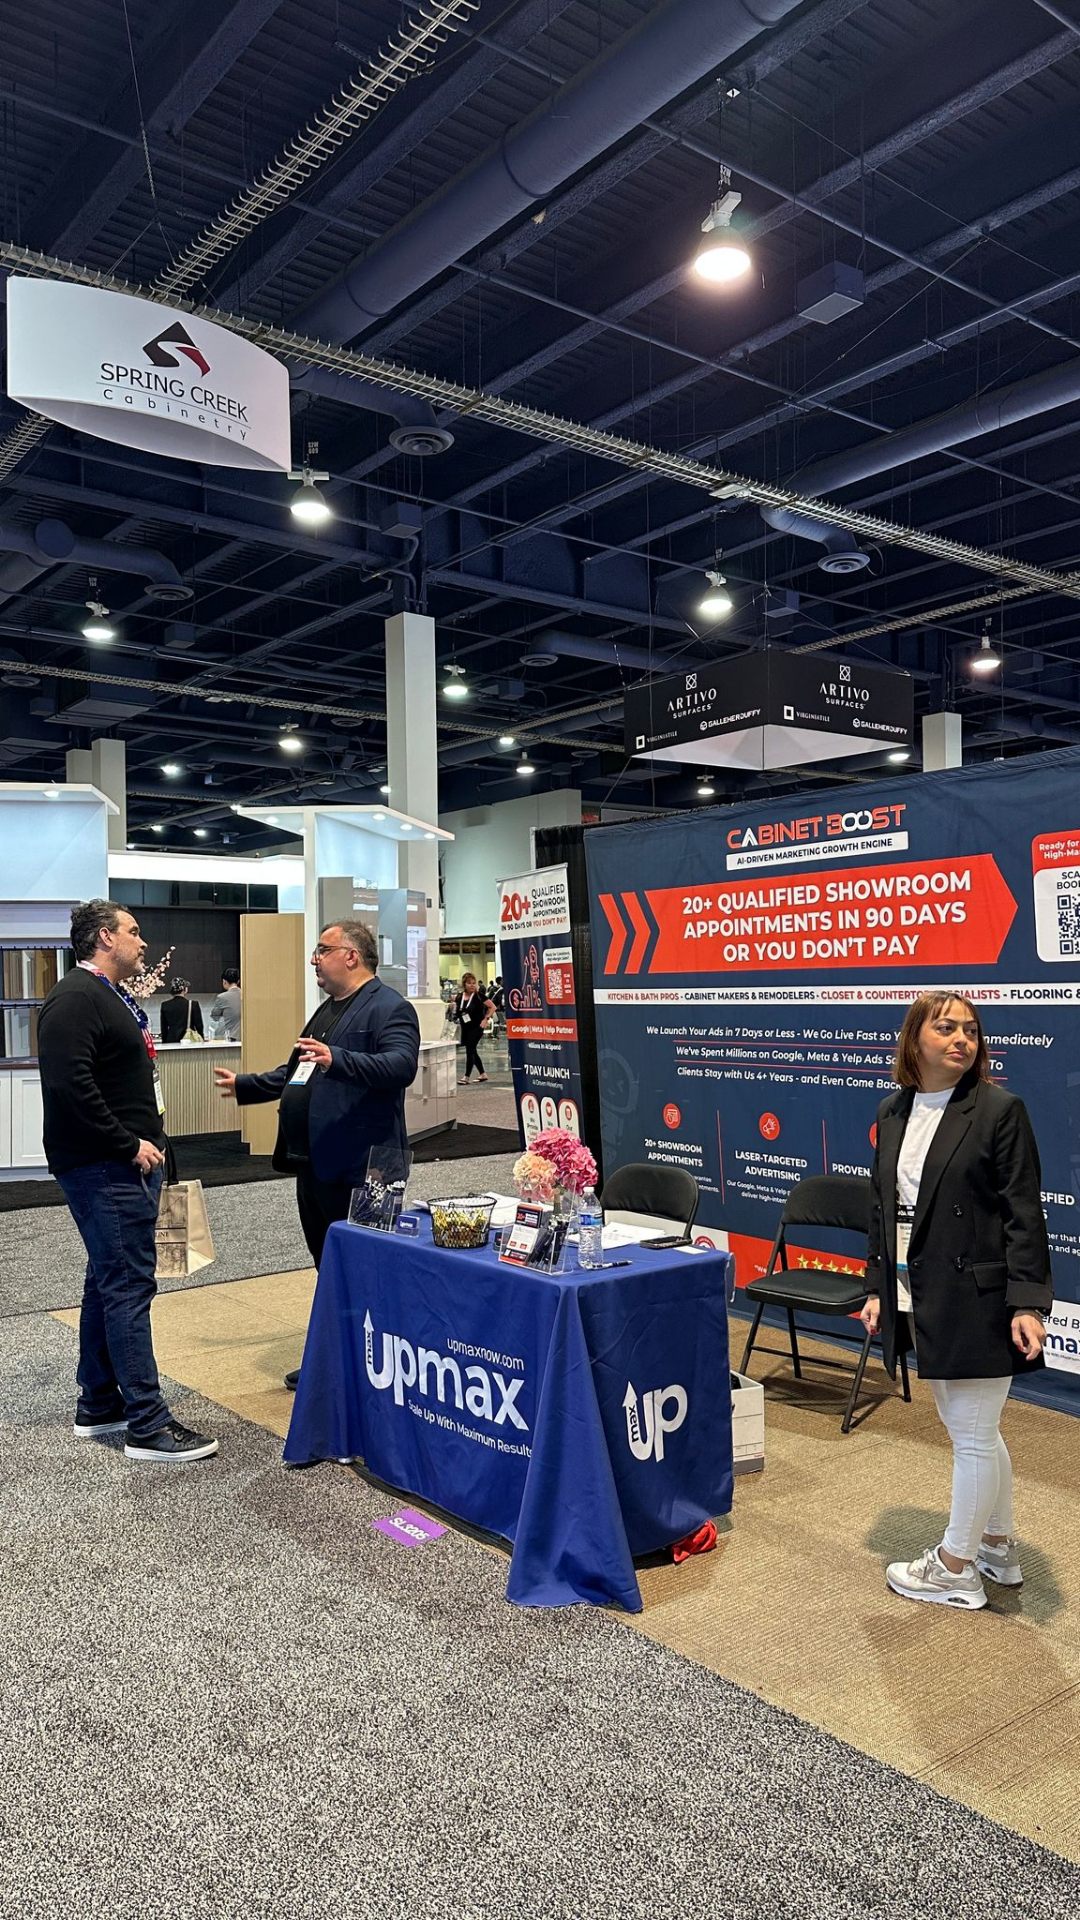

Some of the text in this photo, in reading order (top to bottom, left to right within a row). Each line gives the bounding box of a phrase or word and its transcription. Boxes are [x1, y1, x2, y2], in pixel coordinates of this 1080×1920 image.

[101, 362, 248, 422] SPRING CREEK
[667, 688, 717, 712] ARTIVO
[819, 682, 870, 701] ARTIVO
[825, 698, 865, 709] SURFACES
[726, 803, 907, 849] CABINET BOOST
[737, 838, 893, 865] AI-DRIVEN MARKETING GROWTH ENGINE
[1039, 840, 1079, 851] Ready for
[682, 870, 971, 915] 20+ QUALIFIED SHOWROOM
[501, 883, 565, 923] 20+ QUALIFIED
[532, 895, 566, 909] SHOWROOM
[683, 901, 967, 939] APPOINTMENTS IN 90 DAYS
[723, 935, 919, 963] OR YOU DON'T PAY
[607, 993, 634, 1001] KITCHEN
[640, 992, 659, 1001] BATH
[660, 992, 679, 1000] PROS
[684, 992, 716, 1000] CABINET
[717, 992, 750, 1000] MAKERS
[751, 991, 757, 1000] &
[758, 991, 815, 1000] REMODELERS
[820, 991, 855, 1000] CLOSET
[856, 991, 863, 1000] &
[1010, 989, 1073, 999] FLOORING
[556, 1026, 574, 1034] Partner
[646, 1026, 659, 1034] We
[660, 1027, 688, 1035] Launch
[689, 1027, 707, 1036] Your
[708, 1027, 724, 1036] Ads
[725, 1027, 733, 1036] in
[735, 1028, 740, 1037] 7
[742, 1028, 763, 1039] Days
[775, 1028, 795, 1038] Less
[803, 1029, 819, 1039] We
[820, 1030, 833, 1039] Go
[835, 1029, 854, 1039] Live
[856, 1030, 877, 1040] Fast
[879, 1032, 892, 1041] so
[676, 1046, 700, 1056] We've
[700, 1047, 724, 1058] Spent
[725, 1048, 757, 1058] Millions
[758, 1051, 770, 1059] on
[771, 1050, 804, 1062] Google,
[807, 1052, 831, 1062] Meta
[832, 1053, 839, 1062] &
[841, 1053, 862, 1065] Yelp
[864, 1054, 883, 1064] Ads
[989, 1059, 1004, 1070] To
[524, 1064, 570, 1079] 7 DAY LAUNCH
[677, 1066, 703, 1077] Clients
[704, 1068, 723, 1080] Stay
[724, 1069, 743, 1079] with
[744, 1071, 755, 1080] Us
[756, 1071, 768, 1080] 4+
[769, 1072, 794, 1083] Years
[800, 1074, 820, 1084] and
[821, 1075, 844, 1086] Even
[846, 1076, 874, 1088] Come
[644, 1138, 703, 1154] 20+ SHOWROOM
[647, 1151, 703, 1167] APPOINTMENTS
[735, 1150, 808, 1168] LASER-TARGETED
[744, 1166, 801, 1182] ADVERTISING
[726, 1179, 737, 1187] Our
[774, 1187, 787, 1196] Yelp
[741, 1191, 758, 1199] deliver
[1060, 1233, 1077, 1243] that
[1055, 1246, 1070, 1254] and
[447, 1337, 525, 1371] upmaxnow.com
[423, 1408, 435, 1424] Up
[436, 1413, 456, 1432] With
[456, 1422, 496, 1449] Maximum
[628, 1405, 640, 1443] max
